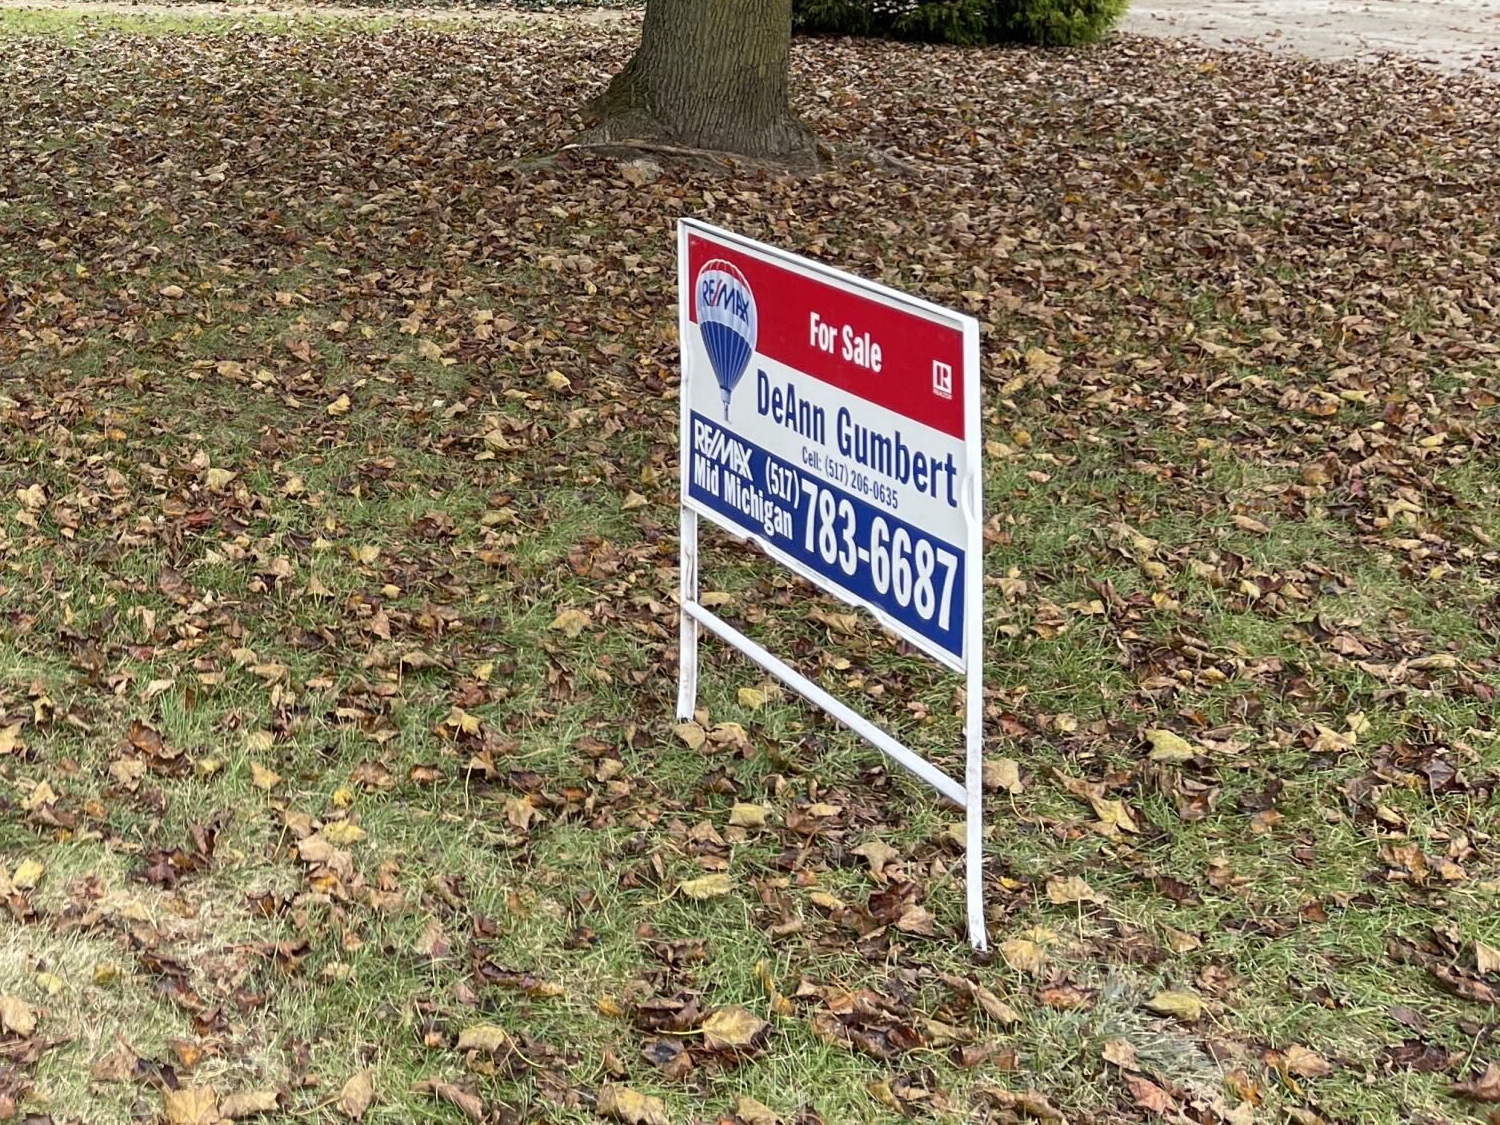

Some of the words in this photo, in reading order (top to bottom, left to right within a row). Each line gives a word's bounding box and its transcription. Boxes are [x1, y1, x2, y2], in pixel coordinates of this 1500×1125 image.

[703, 278, 749, 327] RE/MAX
[810, 311, 837, 354] For
[842, 324, 882, 373] Sale
[694, 418, 754, 482] RE/MAX
[757, 368, 826, 445] DeAnn
[837, 406, 958, 508] Gumbert
[694, 452, 719, 497] Mid
[723, 469, 793, 540] Michigan
[802, 445, 822, 472] Cell:
[825, 456, 849, 486] (517)
[851, 470, 899, 510] 206-0635
[765, 456, 800, 509] (517)
[801, 477, 958, 632] 783-6687
